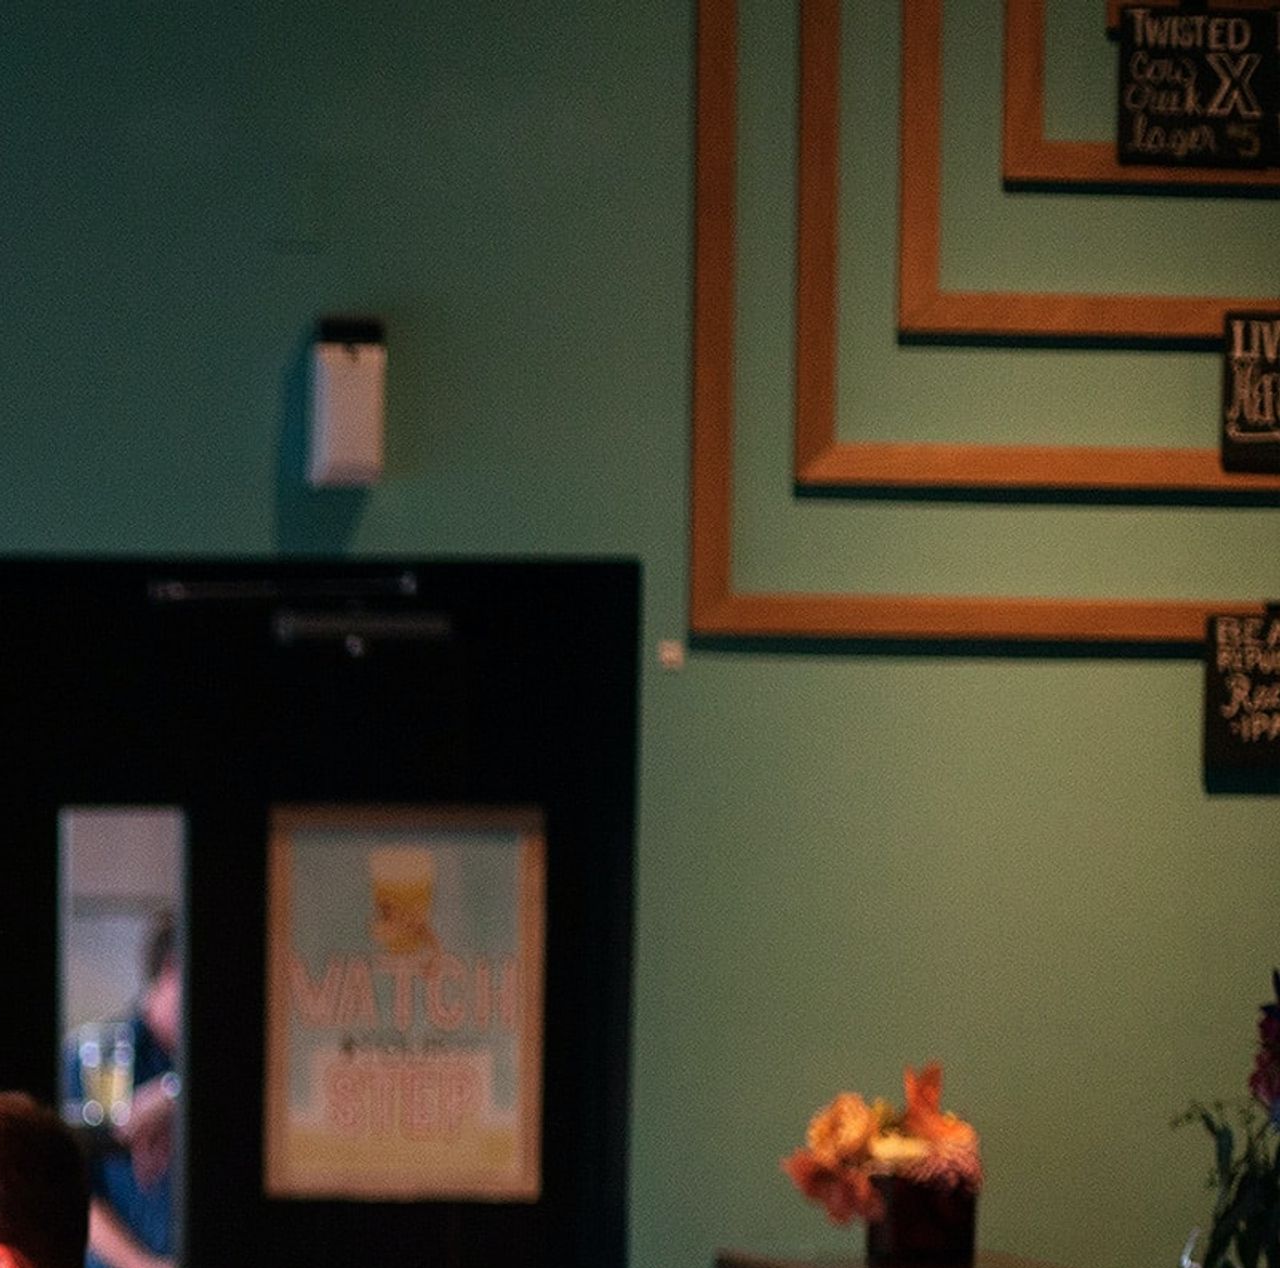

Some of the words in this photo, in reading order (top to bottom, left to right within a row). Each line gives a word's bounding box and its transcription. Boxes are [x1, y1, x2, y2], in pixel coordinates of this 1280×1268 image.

[1125, 8, 1252, 51] TWISTED
[1204, 52, 1263, 119] X
[290, 954, 517, 1032] WATCH
[326, 1064, 477, 1138] STEP
